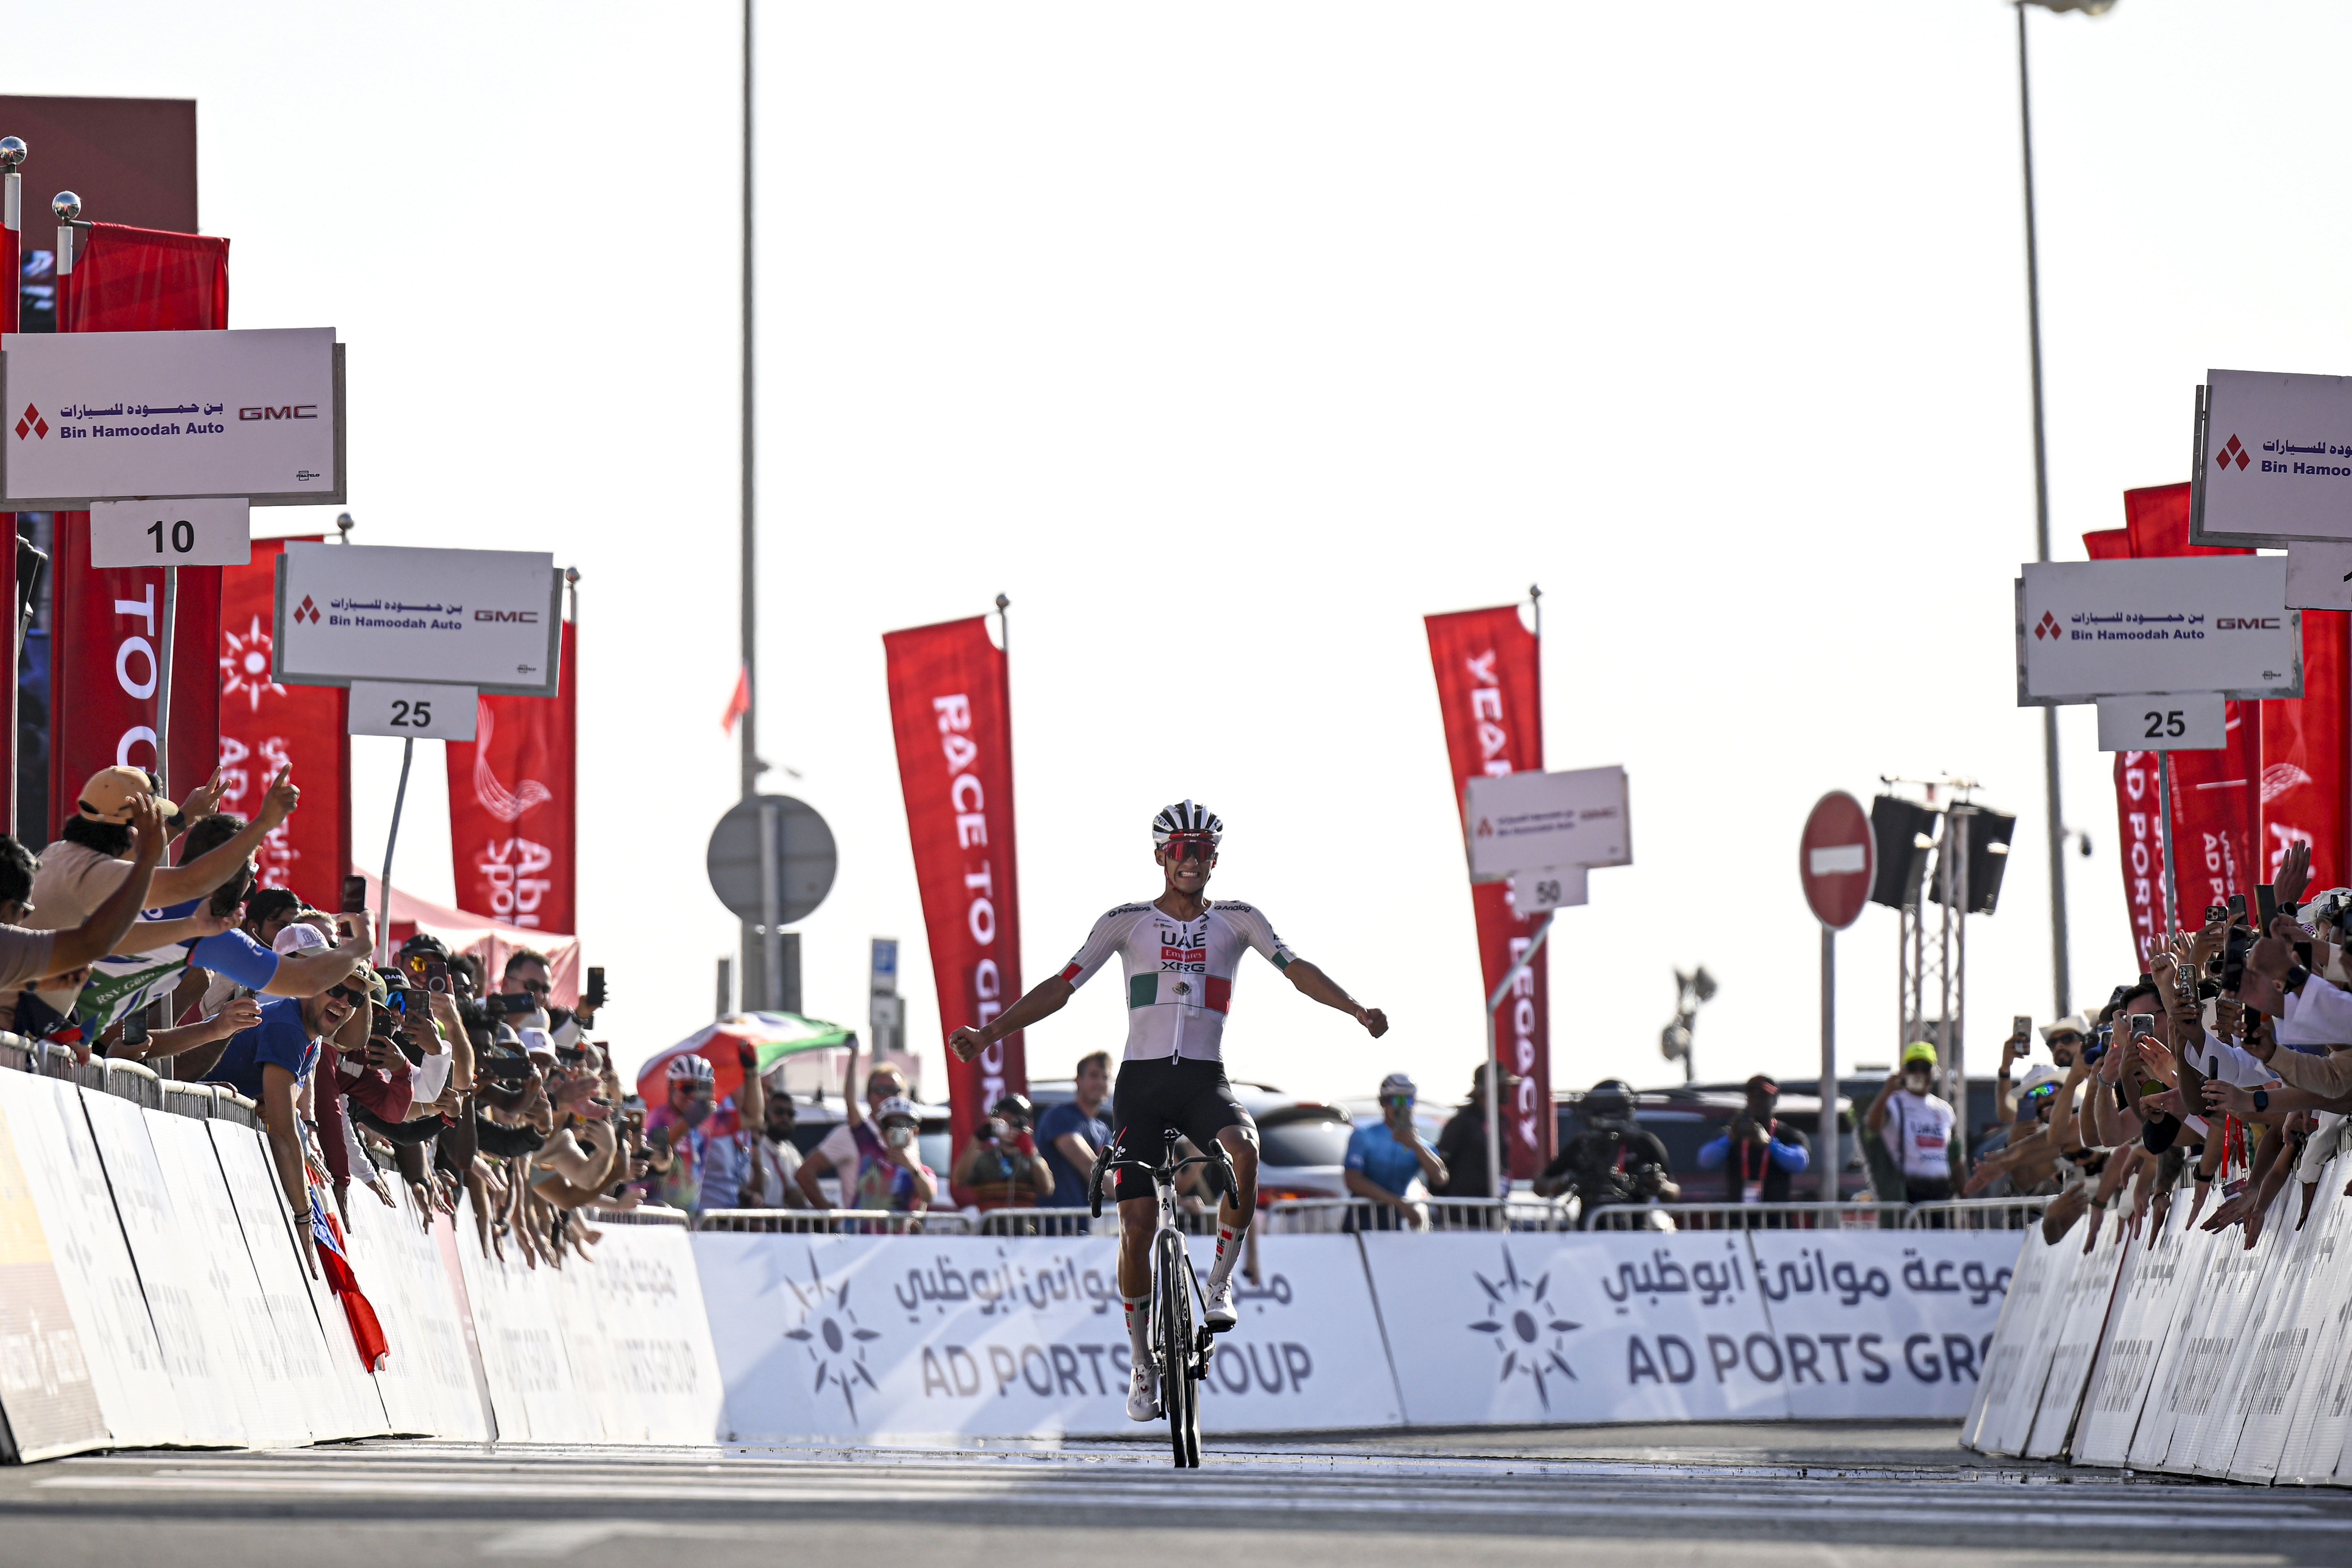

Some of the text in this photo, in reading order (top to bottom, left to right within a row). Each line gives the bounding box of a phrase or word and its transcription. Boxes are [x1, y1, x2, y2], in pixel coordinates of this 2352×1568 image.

[60, 403, 123, 419] للسيارات
[204, 402, 223, 416] بن
[239, 405, 318, 421] GMC
[61, 422, 224, 438] Bin Hamoodah Auto
[2263, 439, 2325, 455] للسيارات
[2261, 460, 2352, 476] Bin Hamoo
[147, 521, 195, 553] 10
[330, 598, 381, 611] للسيارات
[446, 604, 463, 614] بن
[330, 615, 462, 630] Bin Hamoodah Auto
[474, 610, 539, 623] GMC
[2071, 612, 2123, 625] للسيارات
[2188, 613, 2204, 624] بن
[2216, 618, 2281, 629] GMC
[115, 583, 157, 699] TO
[2071, 630, 2205, 640] Bin Hamoodah Auto
[390, 700, 431, 727] 25
[2144, 710, 2186, 738] 25
[2203, 833, 2220, 872] AD
[1537, 880, 1561, 904] 50
[2129, 812, 2154, 960] PORTS
[933, 693, 1006, 1116] RACE TO GLOR
[1221, 904, 1252, 913] Analog
[303, 931, 325, 943] DUB
[1161, 931, 1206, 949] UAE
[1166, 949, 1202, 959] Emiates
[1161, 961, 1205, 972] XRG
[96, 987, 120, 1005] RSV
[1510, 936, 1538, 1150] LEGACY
[1627, 1333, 1696, 1385] AD
[1706, 1331, 1890, 1385] PORTS
[922, 1341, 1313, 1397] AD PORTS OUP
